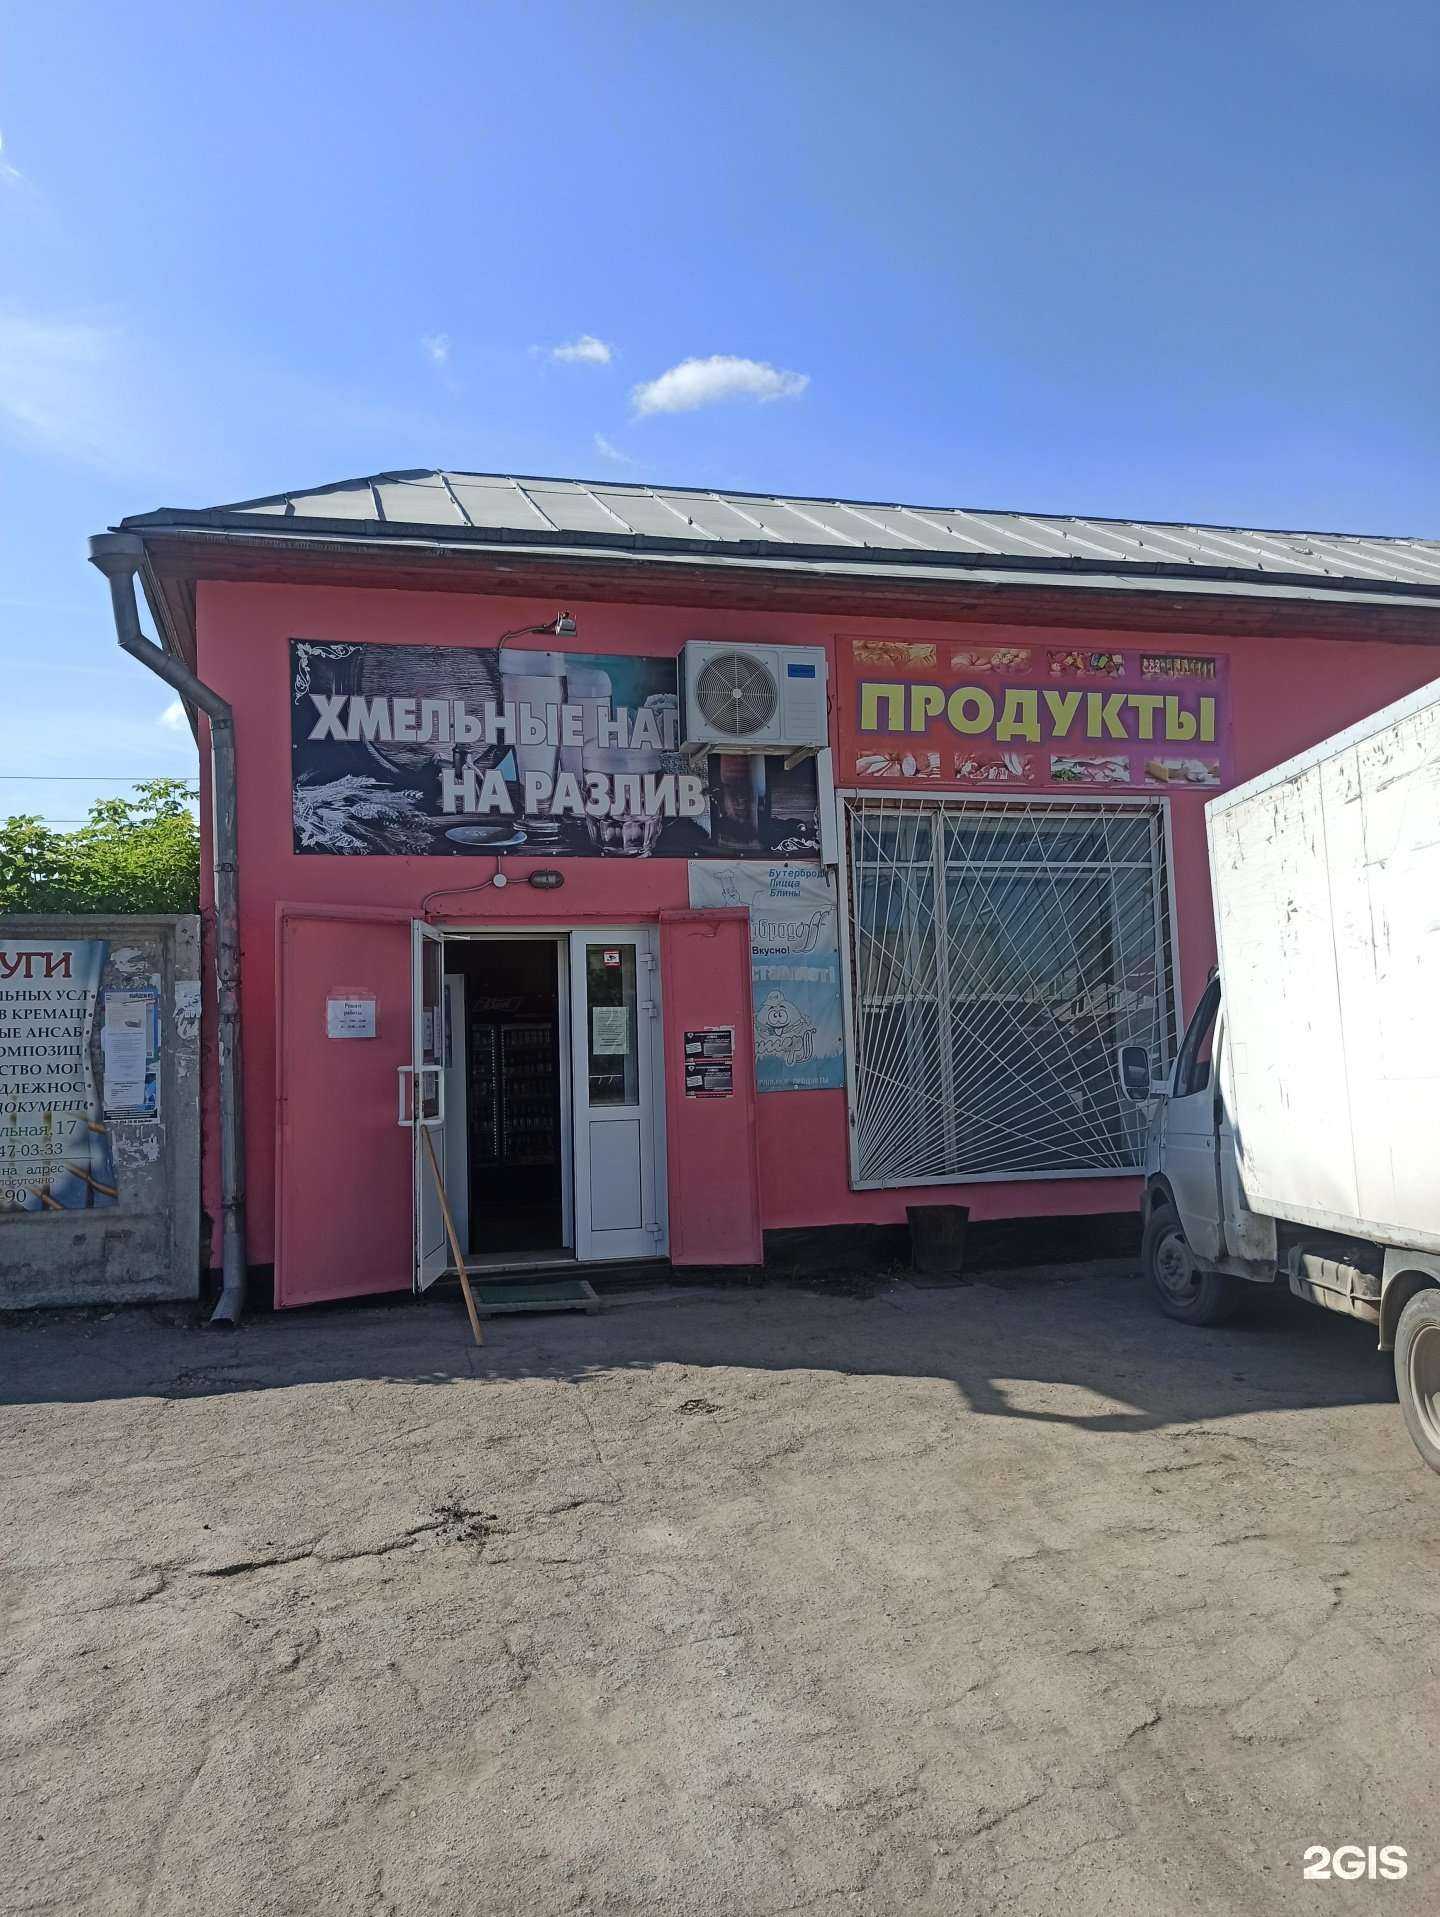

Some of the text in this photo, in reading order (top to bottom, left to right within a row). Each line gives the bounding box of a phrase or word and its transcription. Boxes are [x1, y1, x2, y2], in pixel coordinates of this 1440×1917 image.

[860, 682, 1216, 743] ПРОДУКТЫ
[308, 694, 585, 749] ХМЕЛЬНЫЕ
[441, 768, 708, 818] НА РАЗЛИВ
[769, 879, 801, 888] Пицца
[769, 888, 801, 897] Блины
[752, 946, 790, 956] Вкусно!
[0, 952, 73, 979] УГИ
[56, 1120, 77, 1135] 17
[0, 1142, 63, 1157] 47-03-33
